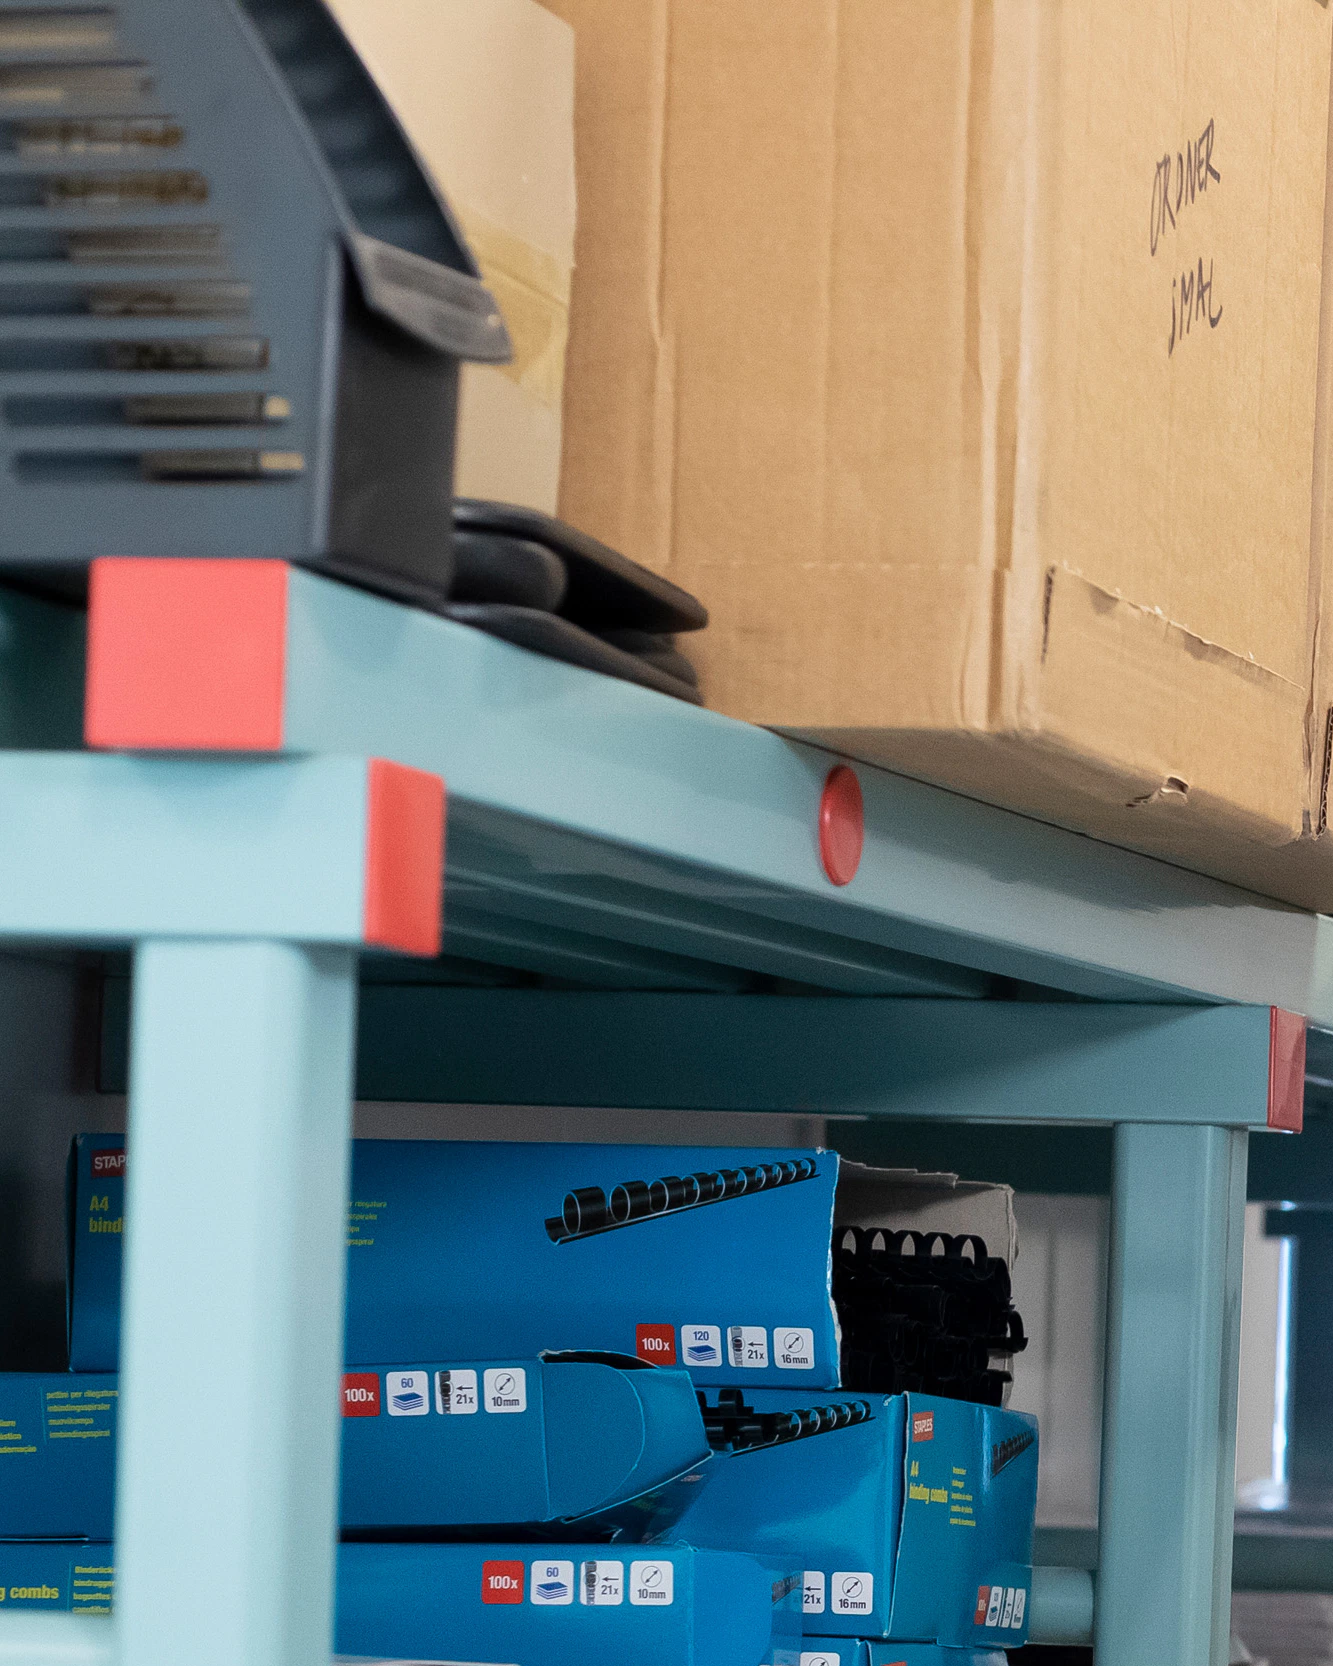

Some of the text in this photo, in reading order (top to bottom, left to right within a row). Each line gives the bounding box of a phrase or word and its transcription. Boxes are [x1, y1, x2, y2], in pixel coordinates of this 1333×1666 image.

[1150, 118, 1220, 256] ORDNER
[94, 1155, 128, 1169] STAP
[89, 1195, 109, 1211] A4
[89, 1217, 123, 1233] bind
[693, 1331, 709, 1341] 120
[642, 1337, 670, 1351] 100x
[747, 1349, 765, 1360] 21x
[401, 1377, 414, 1388] 60
[344, 1388, 375, 1402] 100x
[456, 1394, 475, 1405] 21x
[914, 1418, 933, 1434] STAPLES
[546, 1567, 559, 1578] 60
[488, 1575, 518, 1589] 100x
[10, 1584, 60, 1599] combs
[601, 1584, 619, 1595] 21x
[804, 1593, 821, 1604] 21x
